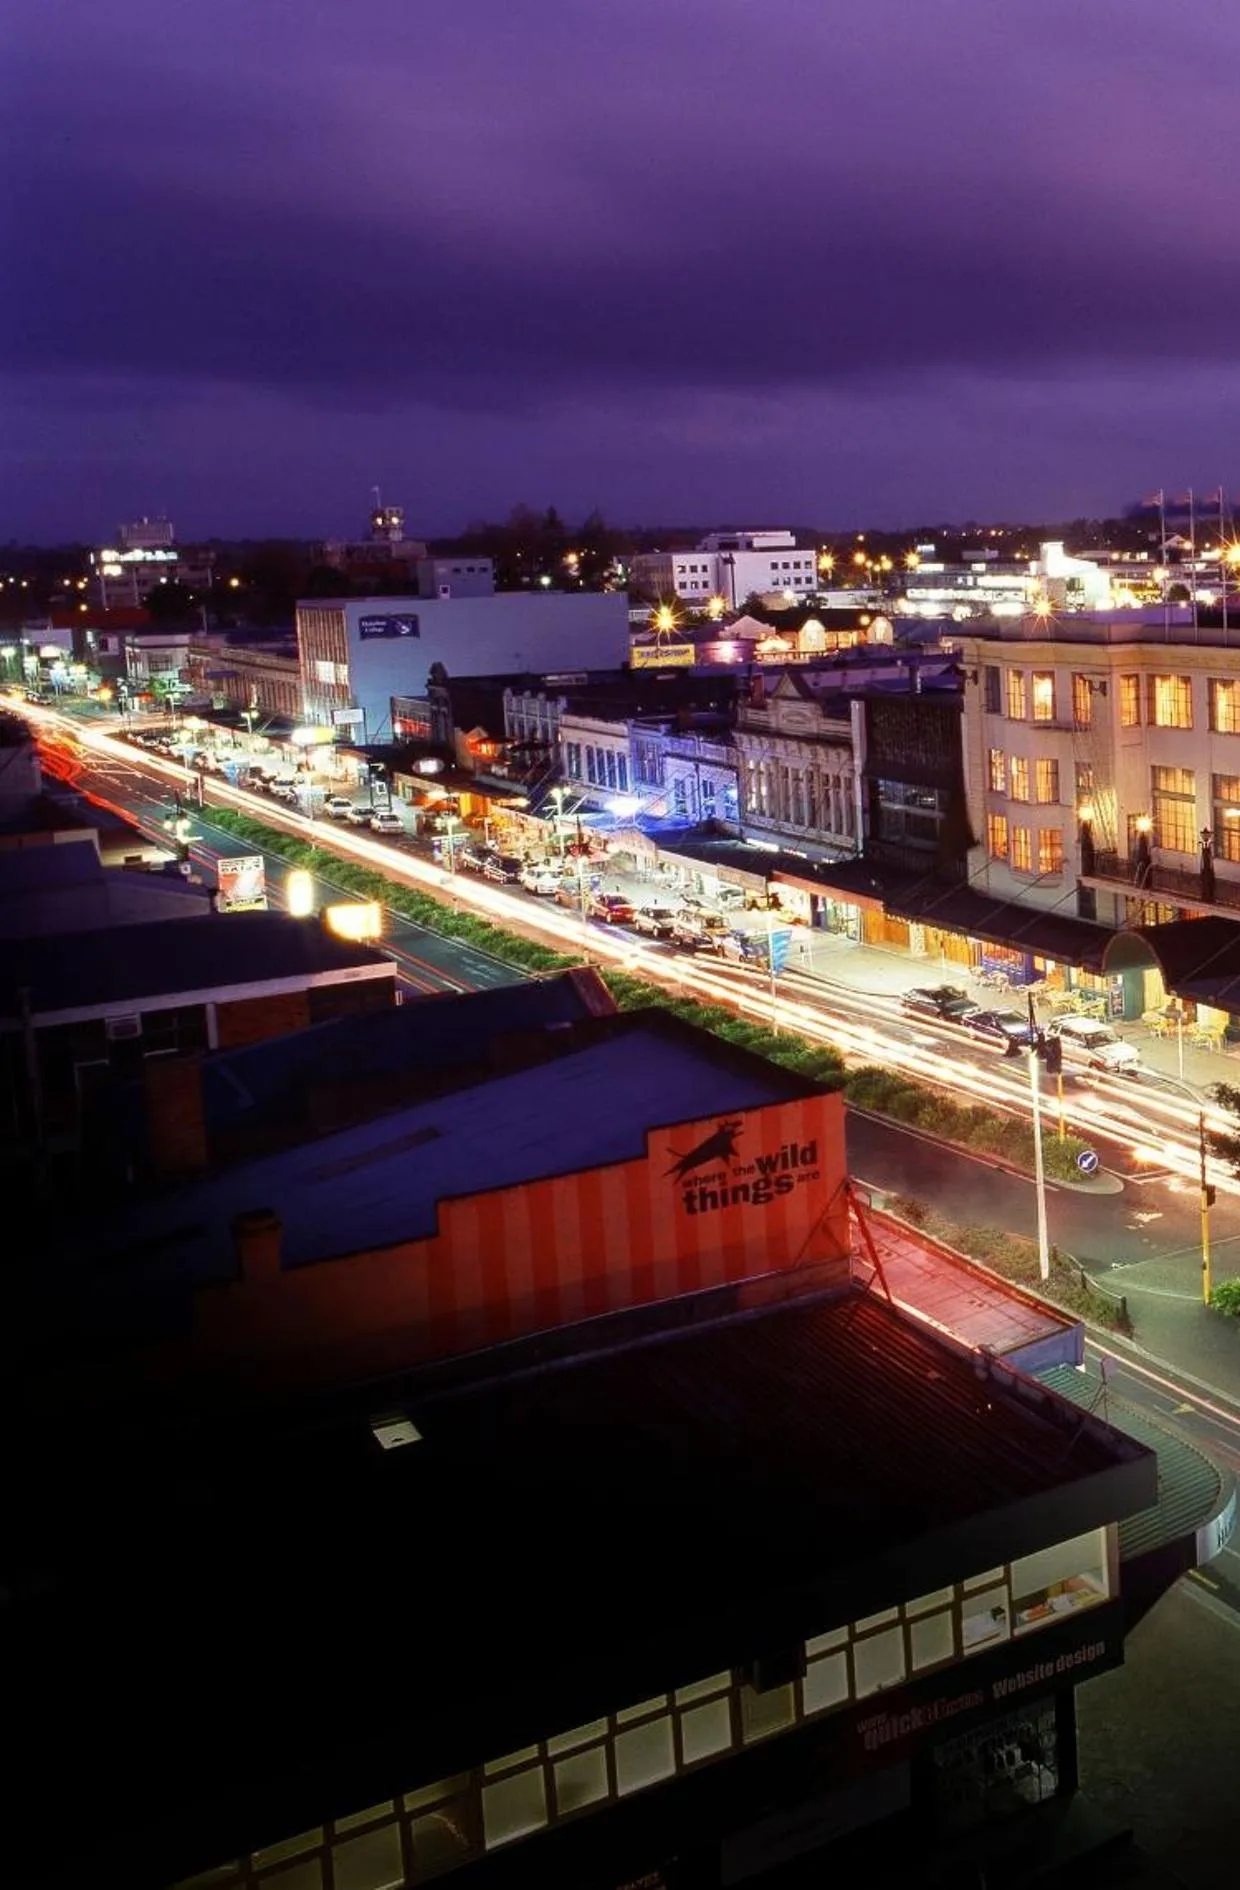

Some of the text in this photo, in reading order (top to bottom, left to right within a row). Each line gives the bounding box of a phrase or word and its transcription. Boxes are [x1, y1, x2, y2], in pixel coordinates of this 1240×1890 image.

[682, 1140, 818, 1188] where the wild
[682, 1170, 821, 1216] things are
[992, 1661, 1054, 1700] Website
[1056, 1640, 1106, 1673] design
